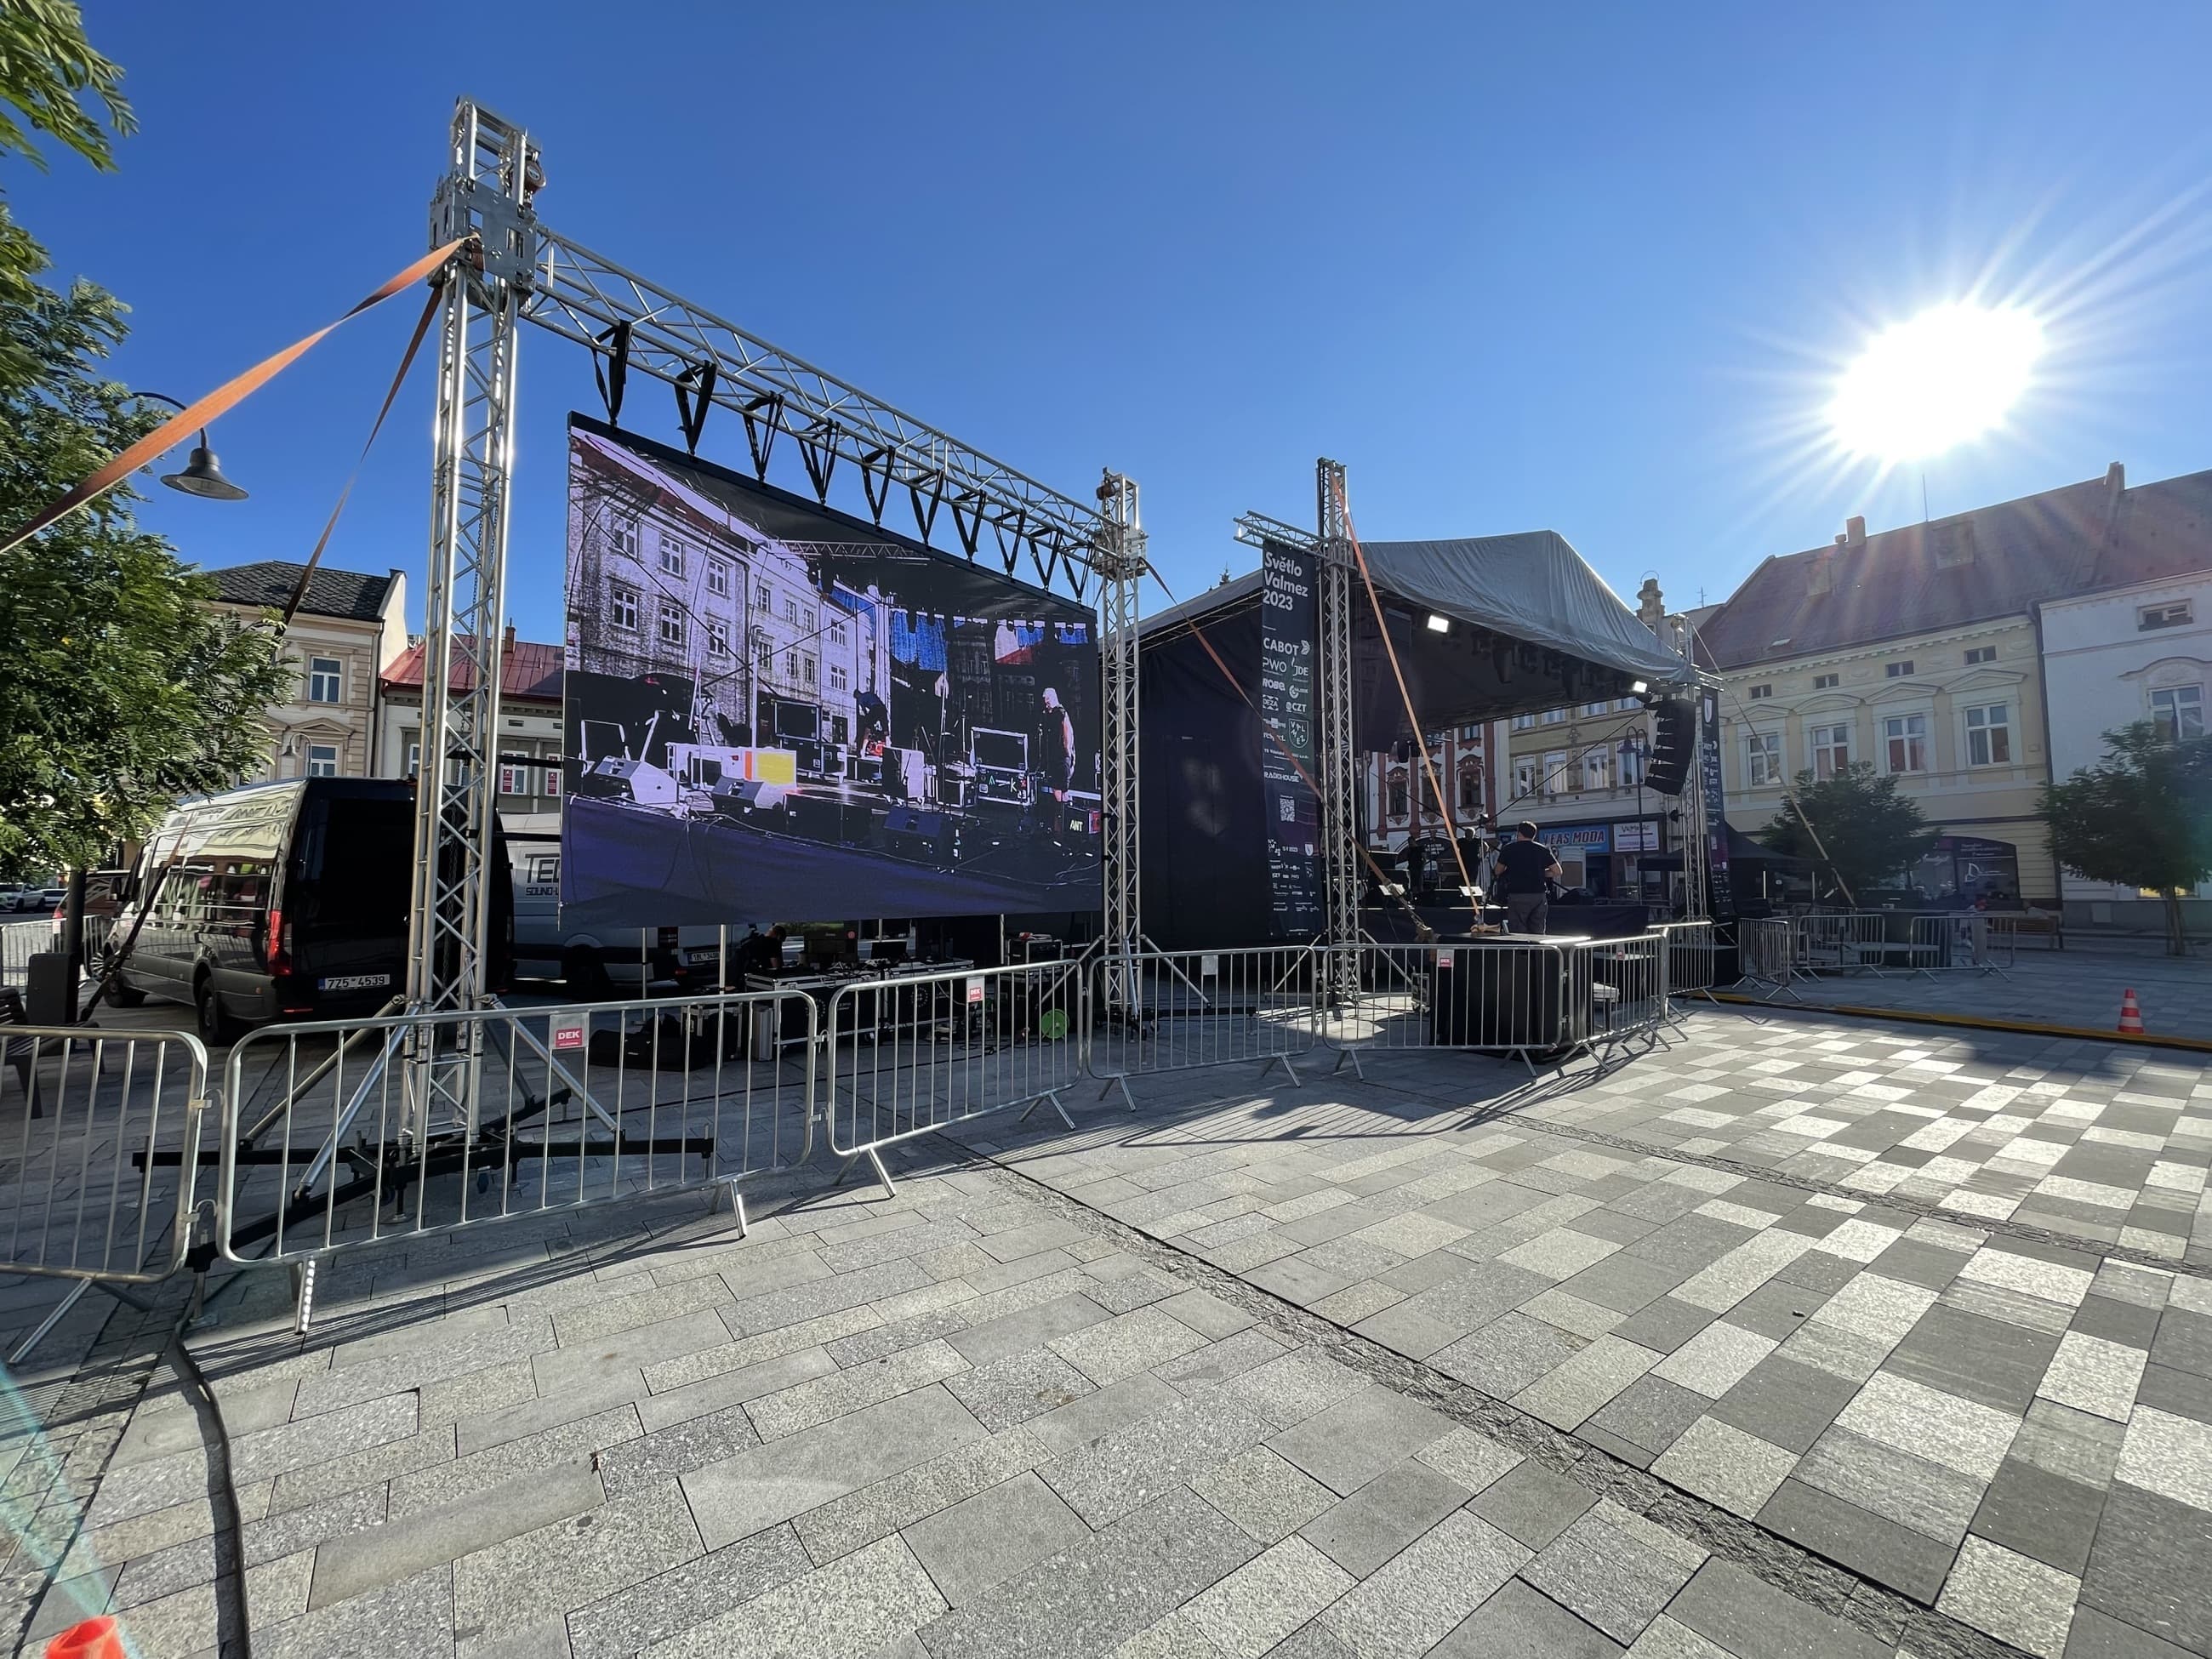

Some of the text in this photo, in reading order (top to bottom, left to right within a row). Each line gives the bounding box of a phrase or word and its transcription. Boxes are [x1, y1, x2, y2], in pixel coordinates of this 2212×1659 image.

[1264, 551, 1303, 577] Světlo
[1264, 569, 1308, 597] Valmez
[1263, 589, 1293, 611] 2023
[1263, 637, 1299, 656] CABOT
[1263, 657, 1287, 673] PWO
[1293, 665, 1308, 676] JDE
[1292, 702, 1307, 712] CZT
[1572, 830, 1605, 842] MODA
[358, 976, 385, 986] 4539
[557, 1030, 580, 1040] DEK
